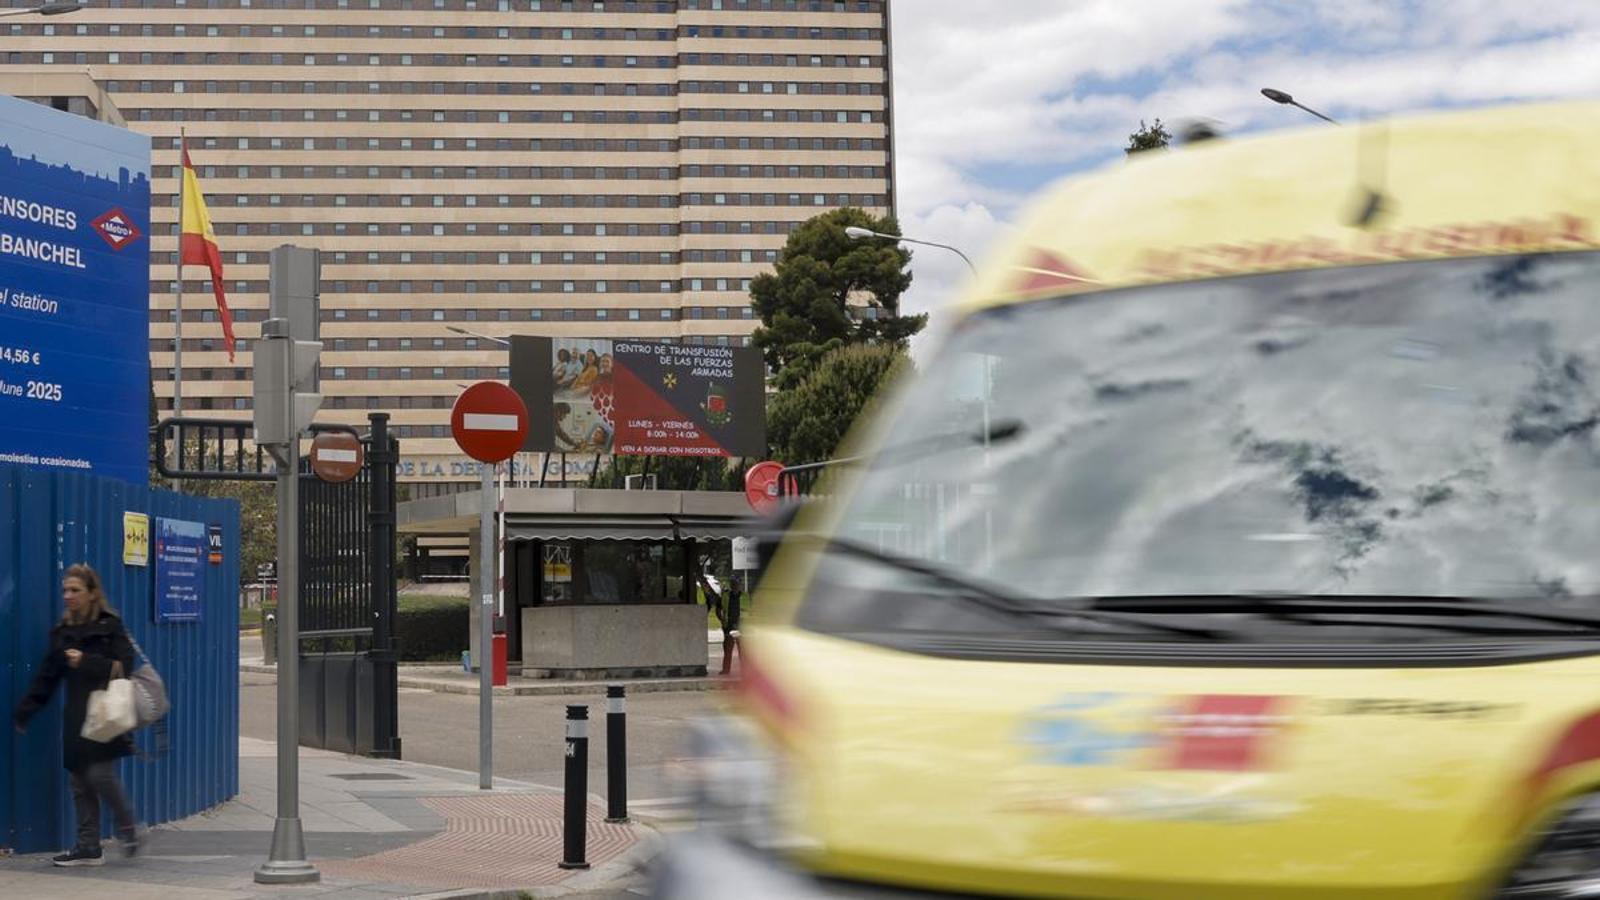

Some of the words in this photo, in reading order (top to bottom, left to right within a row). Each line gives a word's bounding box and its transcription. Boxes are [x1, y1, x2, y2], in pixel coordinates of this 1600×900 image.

[0, 195, 77, 231] NSORES
[105, 223, 129, 236] Metro
[11, 292, 58, 314] station
[616, 344, 652, 354] CENTRO
[655, 346, 667, 355] DE
[670, 346, 733, 358] TRANSFUSIÓN
[32, 352, 41, 365] €
[660, 356, 672, 365] DE
[674, 357, 692, 366] LAS
[694, 358, 733, 368] FUERZAS
[691, 367, 733, 378] ARMADAS
[27, 381, 62, 401] 2025
[629, 420, 653, 428] LUNES
[662, 421, 694, 430] VIERNES
[420, 462, 446, 476] LA
